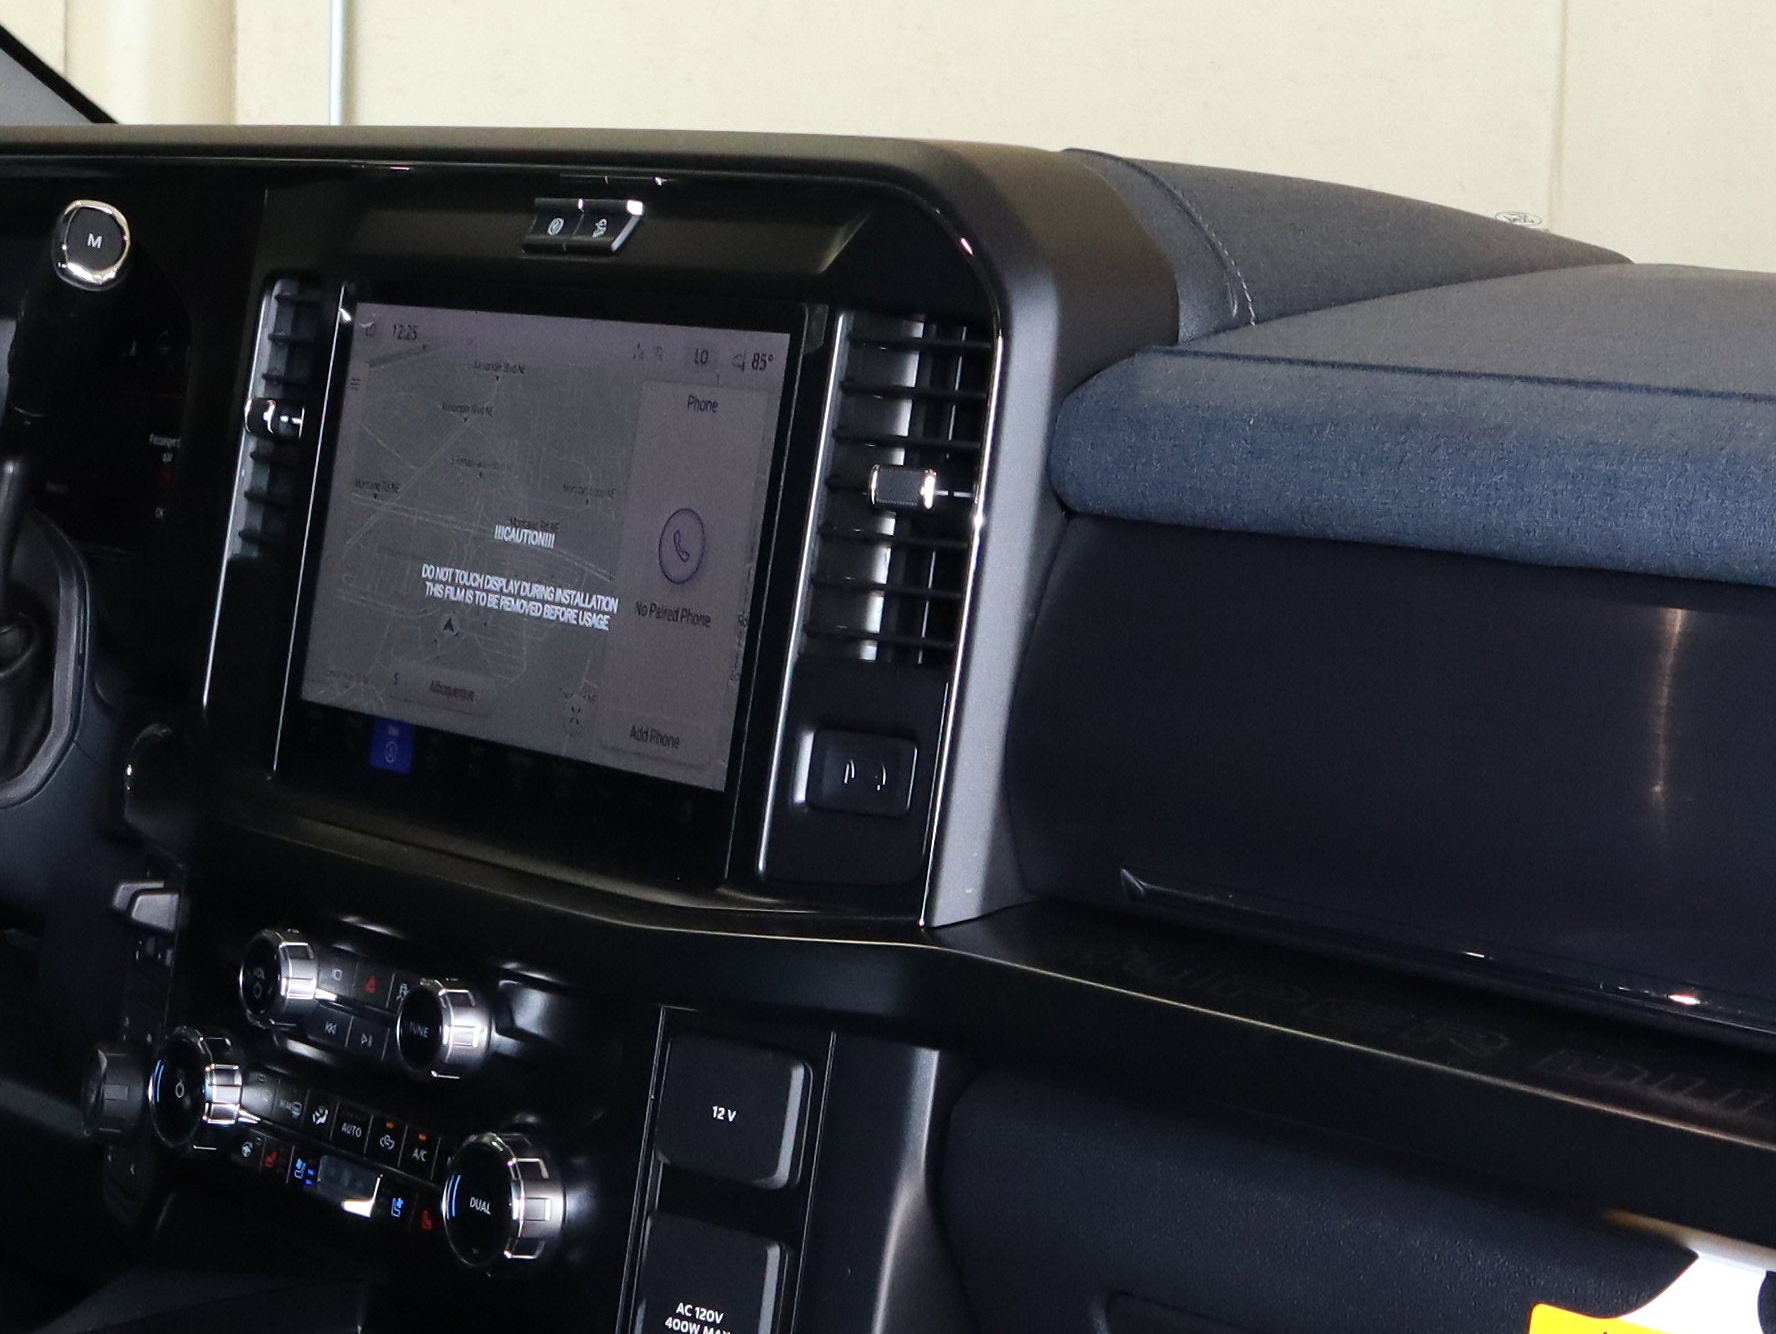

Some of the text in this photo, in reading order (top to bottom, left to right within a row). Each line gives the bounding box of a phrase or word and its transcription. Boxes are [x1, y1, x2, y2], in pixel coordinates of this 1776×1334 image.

[87, 233, 104, 250] M
[687, 393, 719, 415] Phone
[421, 563, 619, 614] DO NOT TOUCH DISPLAY DURING INSTALLATION
[425, 581, 611, 631] THIS FILM IS TO BE REMOVED BEFORE USAGE
[650, 604, 678, 623] Paired
[679, 607, 711, 629] Phone
[629, 725, 680, 750] Add Phone
[711, 1105, 737, 1123] 12 V
[341, 1122, 363, 1138] AUTO
[412, 1147, 428, 1162] A/C
[469, 1196, 492, 1216] DUAL
[675, 1301, 724, 1324] AC 120V
